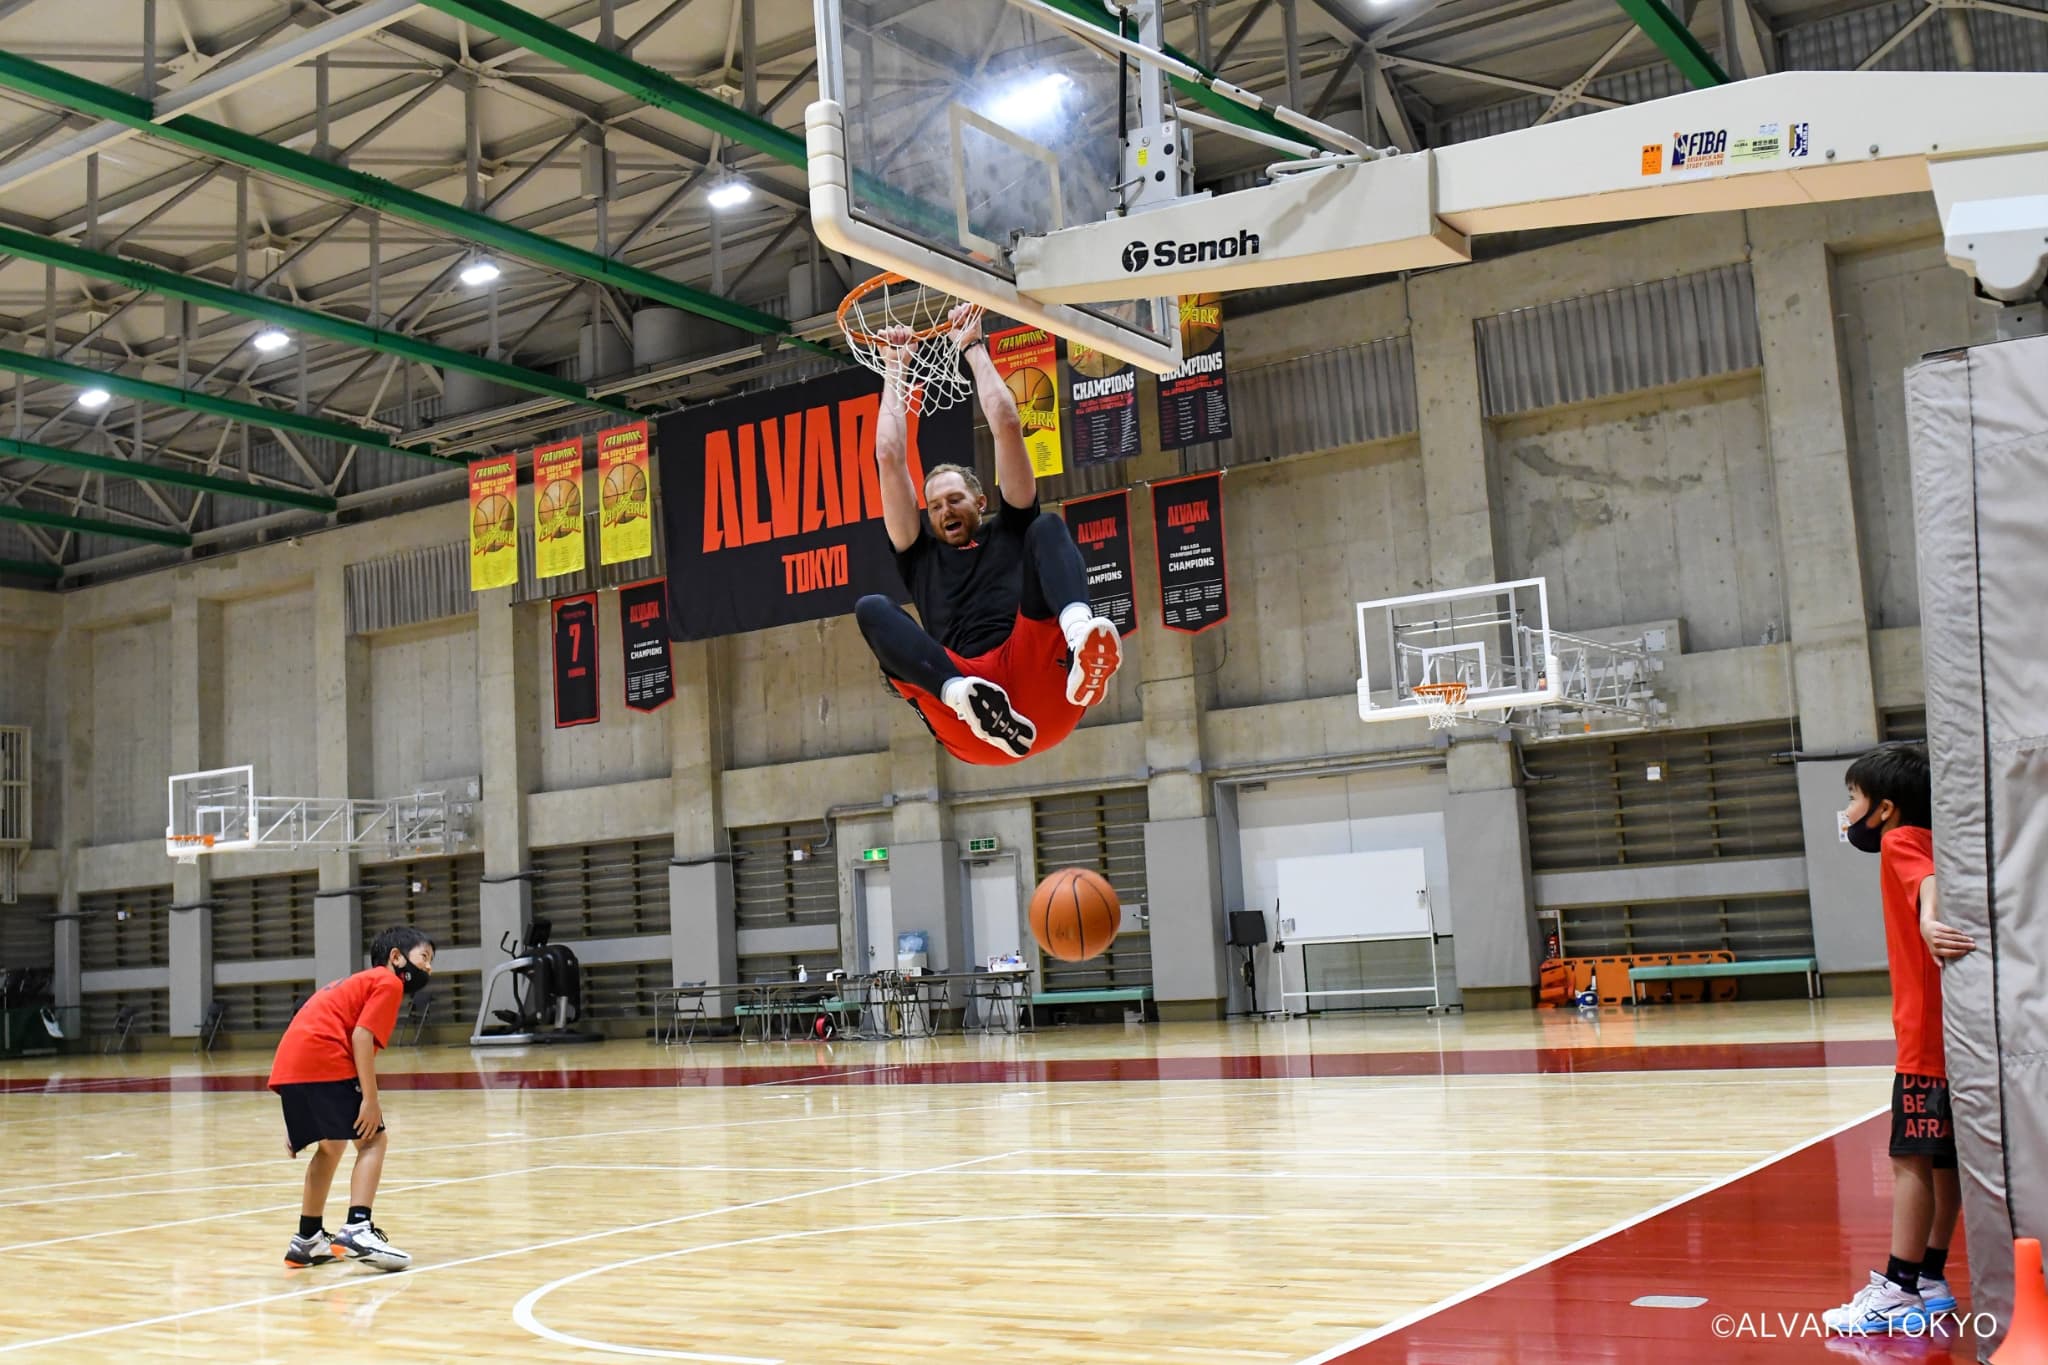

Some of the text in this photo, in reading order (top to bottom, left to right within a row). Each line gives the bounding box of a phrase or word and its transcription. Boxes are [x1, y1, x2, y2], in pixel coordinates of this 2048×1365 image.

[1688, 129, 1727, 156] FIBA
[1154, 229, 1260, 267] Senoh
[997, 329, 1048, 353] CHAMPIONS
[1073, 371, 1135, 401] CHAMPIONS
[1167, 500, 1209, 527] ALVARK
[1078, 517, 1117, 544] ALVARK
[781, 544, 848, 594] TOKYO
[1087, 570, 1122, 585] AMPIONS
[1168, 556, 1215, 572] CHAMPIONS
[569, 623, 581, 662] 7
[631, 646, 662, 660] CHAMPIONS
[1902, 1094, 1926, 1113] BE
